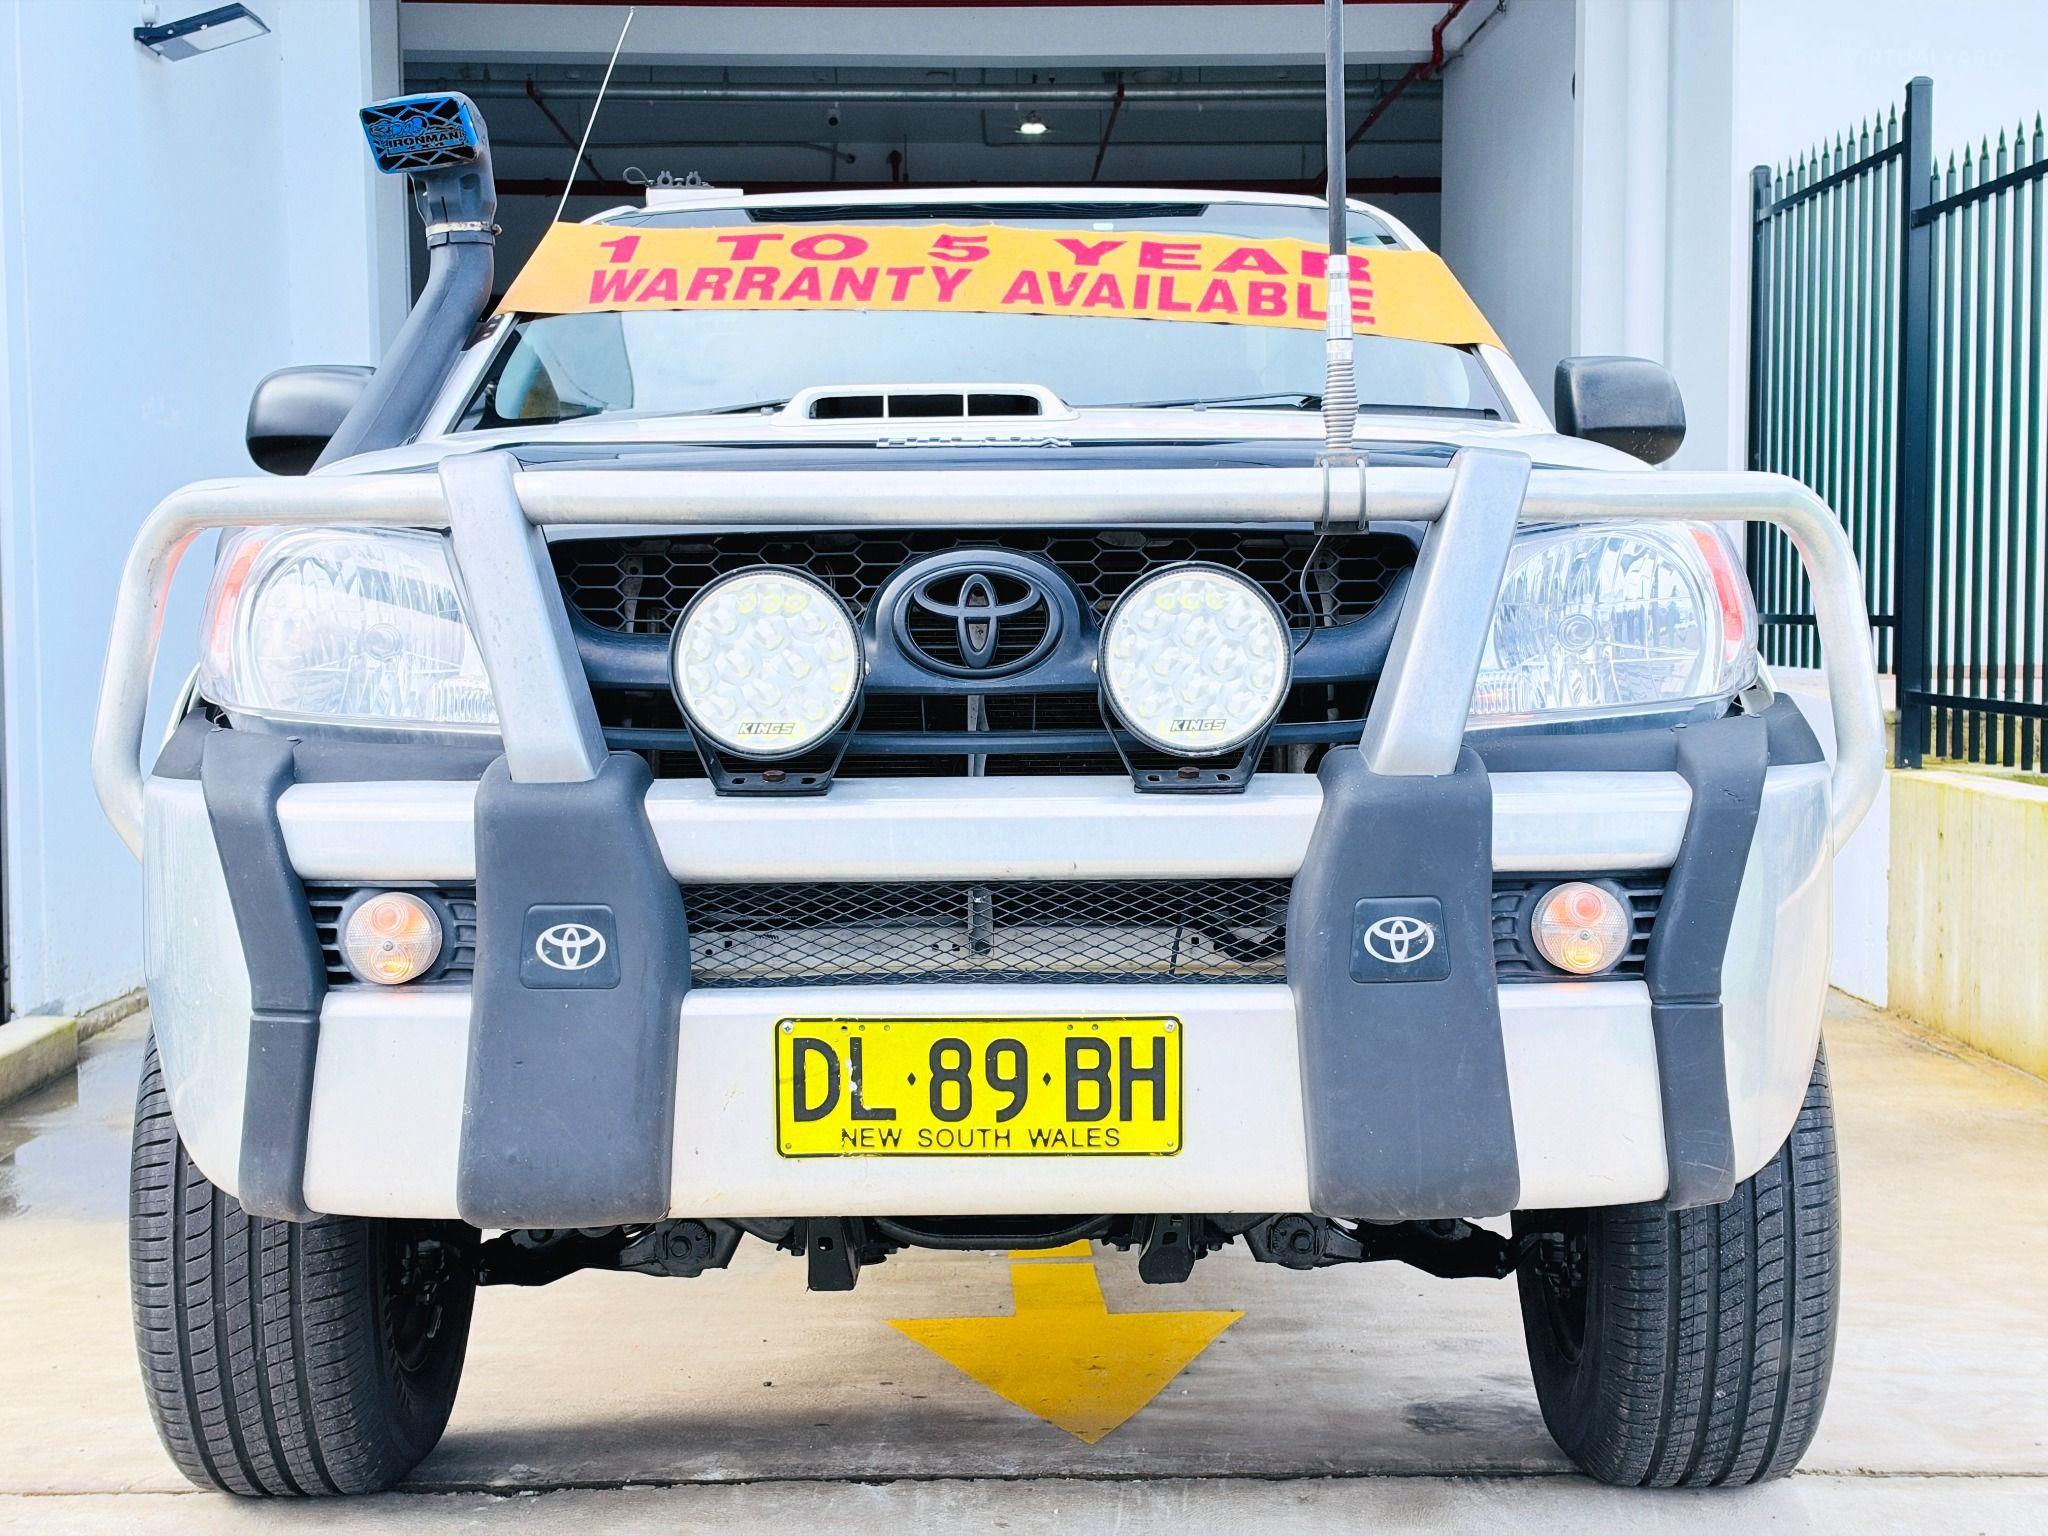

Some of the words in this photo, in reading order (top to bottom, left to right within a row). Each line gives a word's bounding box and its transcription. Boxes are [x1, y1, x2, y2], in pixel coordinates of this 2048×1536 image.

[387, 131, 459, 148] IRONMAN
[601, 235, 640, 263] 1
[717, 233, 868, 261] TO
[928, 234, 990, 263] 5
[1055, 238, 1372, 282] YEAR
[589, 266, 972, 304] WARRANTY
[1002, 270, 1376, 325] AVAILABLE
[738, 722, 795, 734] KINGS
[1170, 719, 1226, 732] KINGS
[841, 1128, 902, 1148] NEW
[918, 1128, 1010, 1148] SOUTH
[1028, 1127, 1120, 1148] WALES
